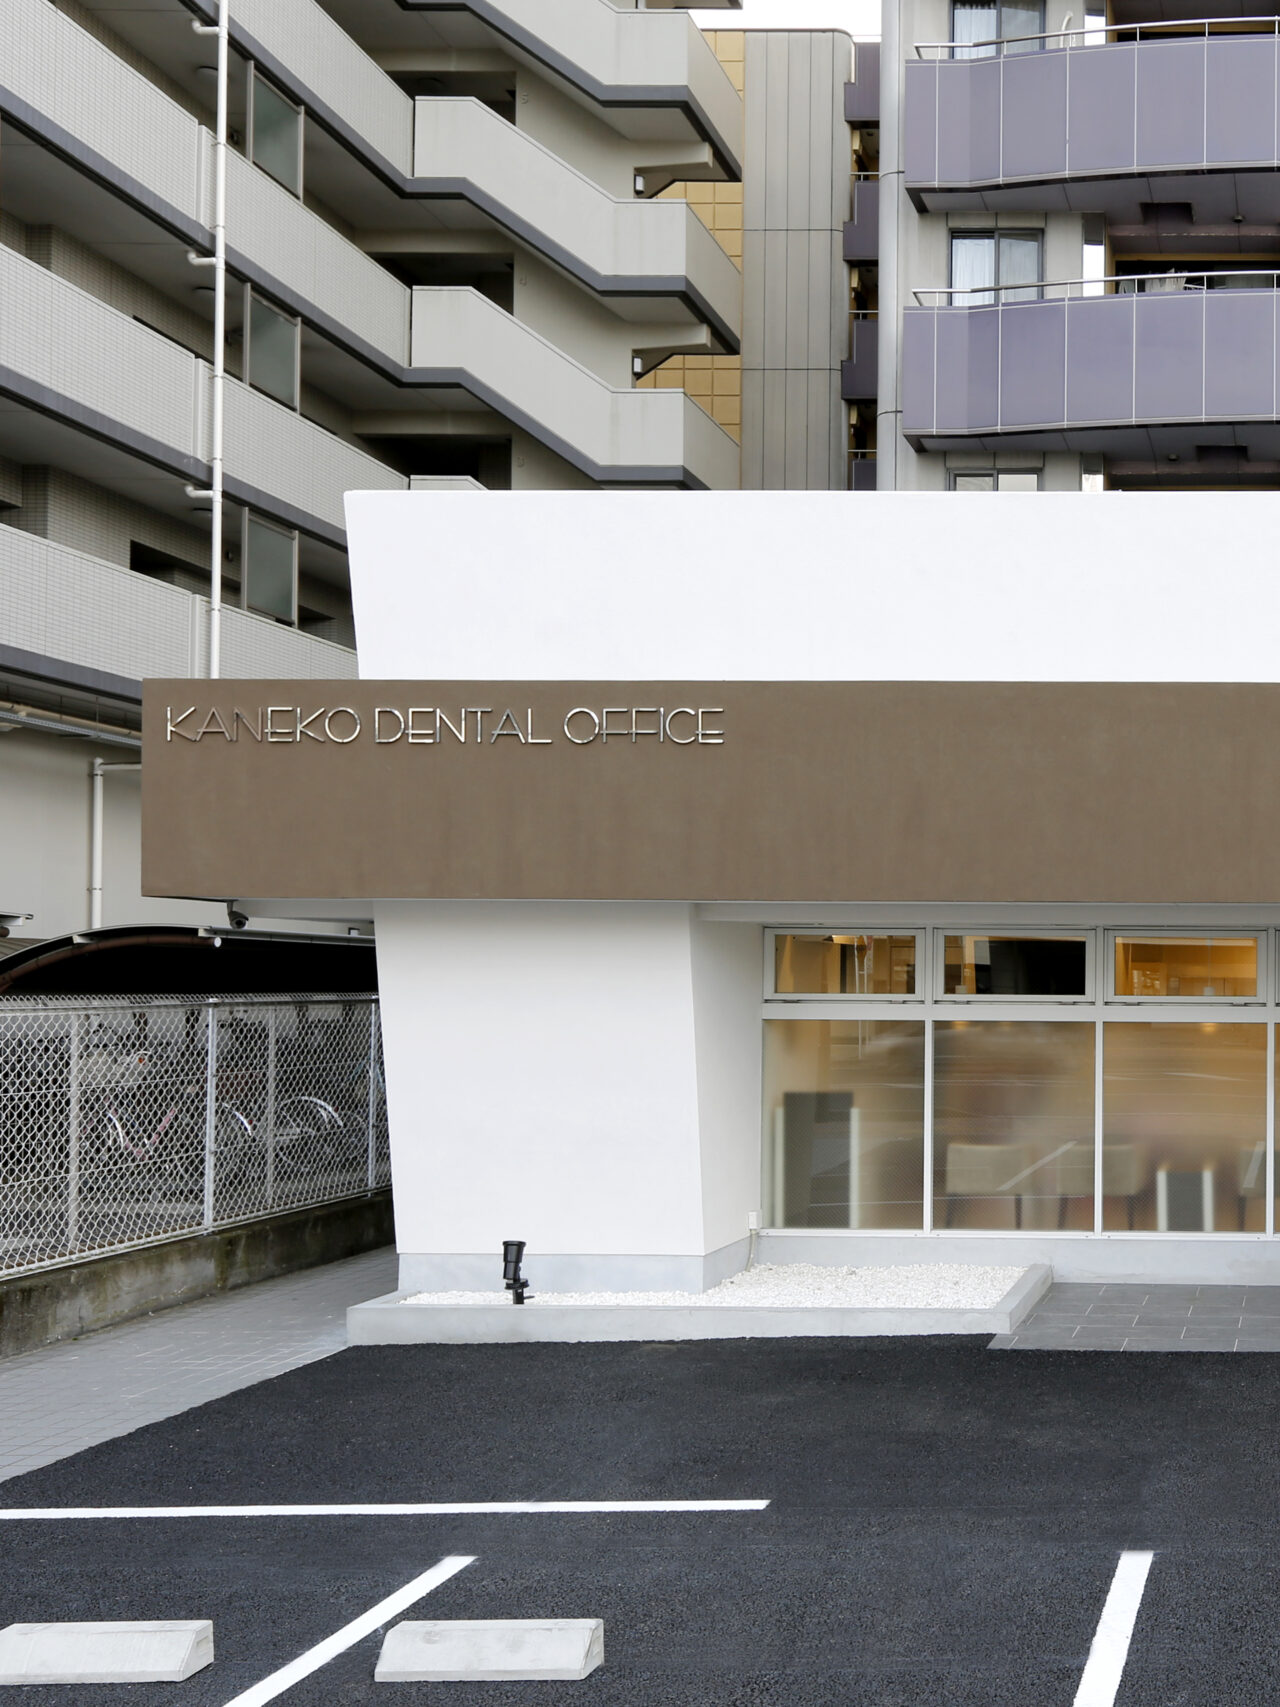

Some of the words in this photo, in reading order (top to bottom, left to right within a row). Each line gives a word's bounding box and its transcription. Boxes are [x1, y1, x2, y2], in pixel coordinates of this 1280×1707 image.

[166, 706, 361, 743] KANEKO
[374, 707, 553, 743] DENTAL
[563, 707, 725, 744] OFFICE
